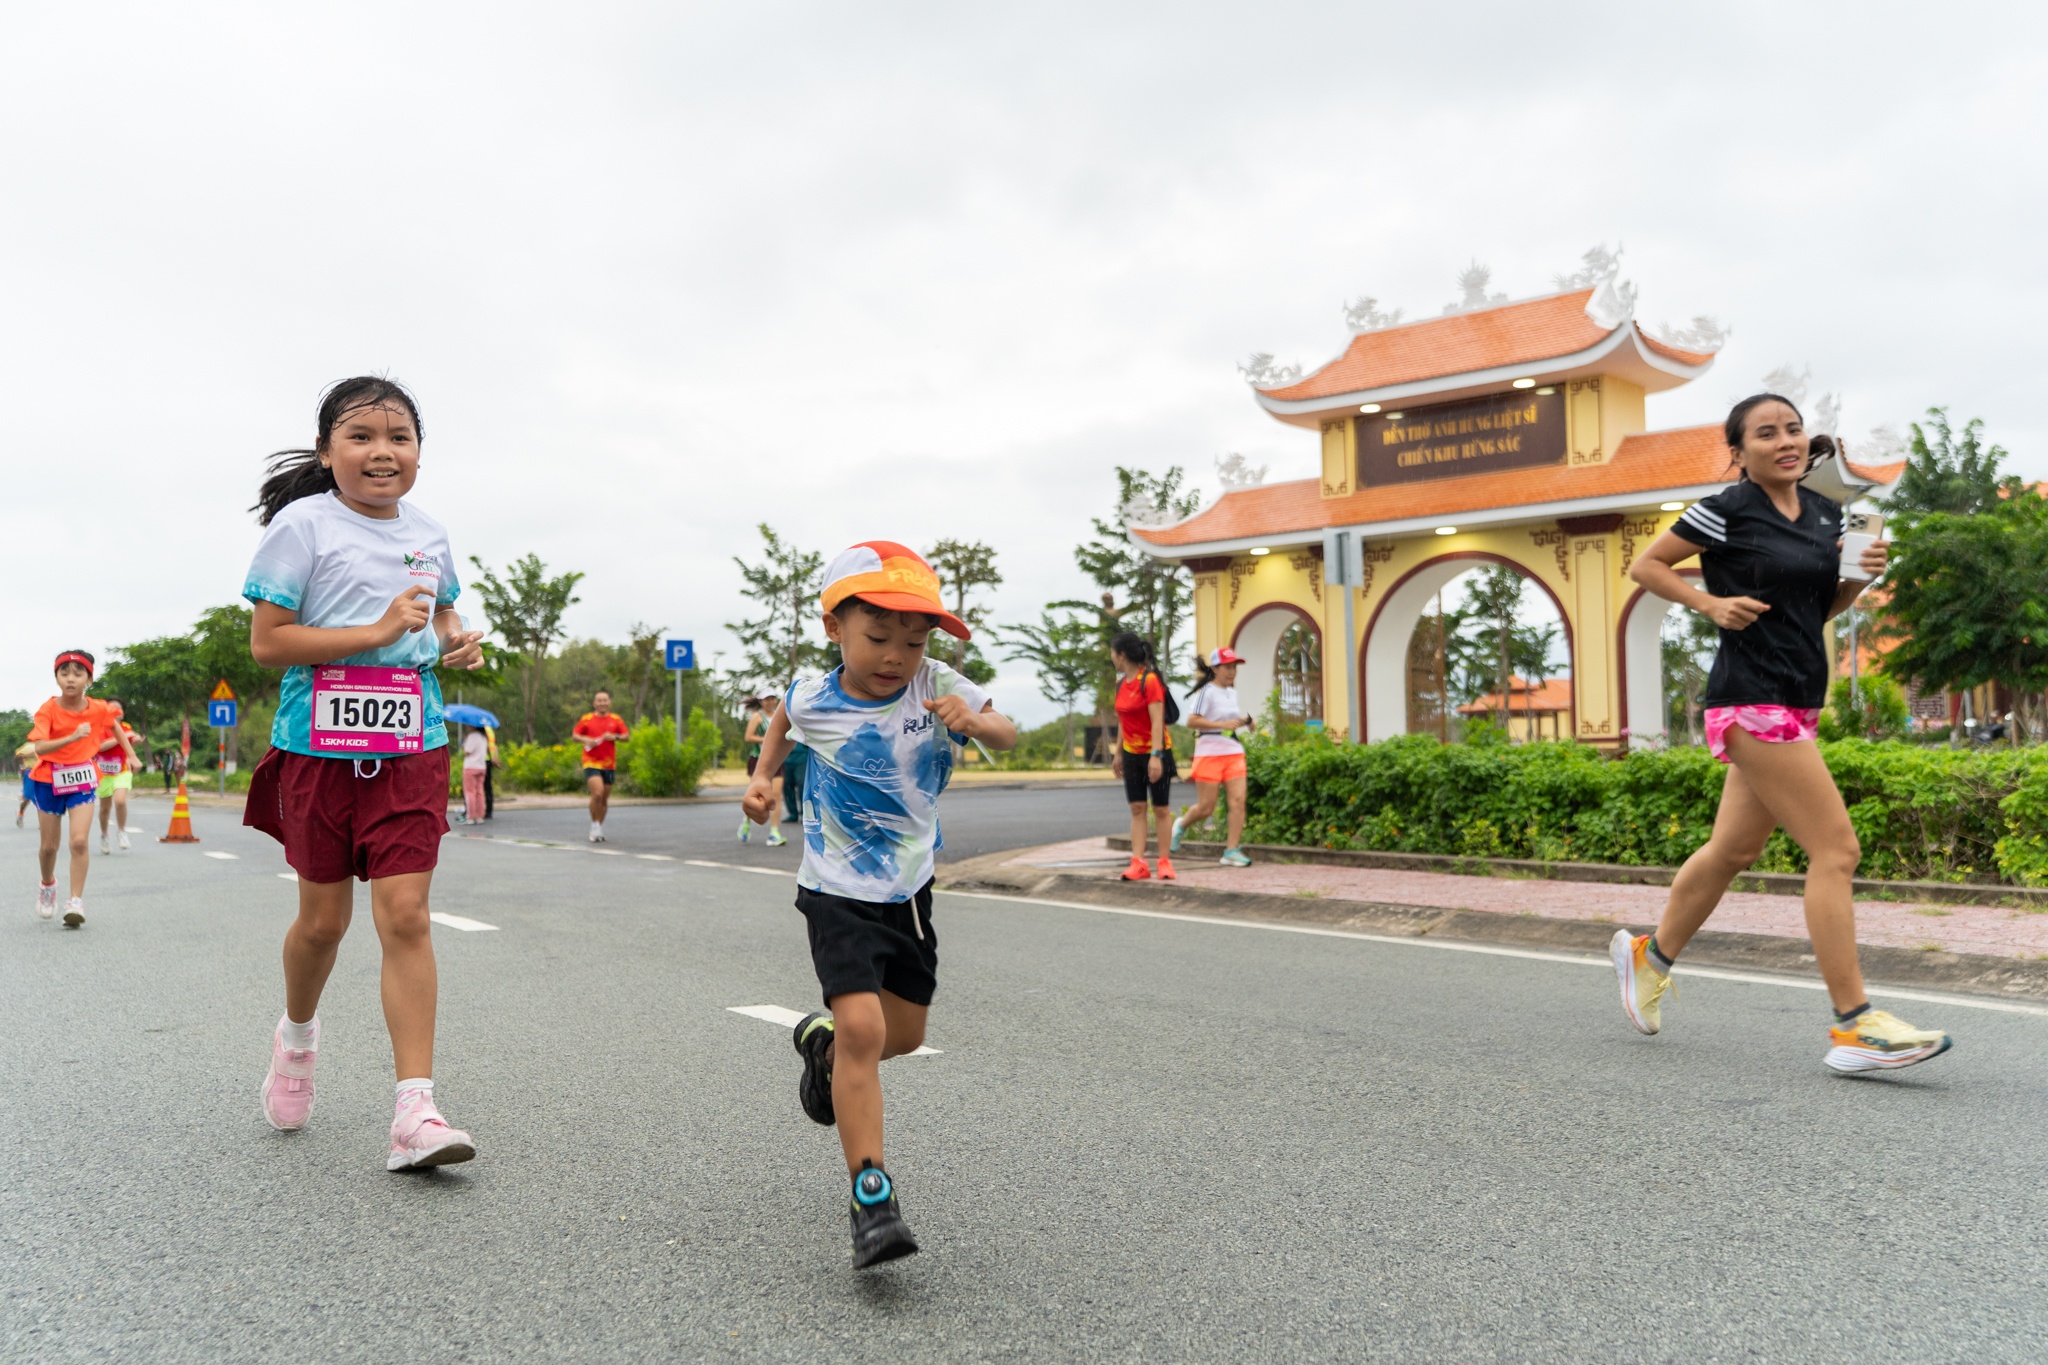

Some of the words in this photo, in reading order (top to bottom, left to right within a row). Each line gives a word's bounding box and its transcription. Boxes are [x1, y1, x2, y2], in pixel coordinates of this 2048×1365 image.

[1434, 421, 1457, 437] ANH
[1434, 445, 1459, 463] KHU
[672, 645, 687, 663] P
[392, 673, 413, 681] HDBank
[329, 697, 412, 729] 15023
[346, 738, 369, 747] KIDS
[61, 769, 93, 785] 15011
